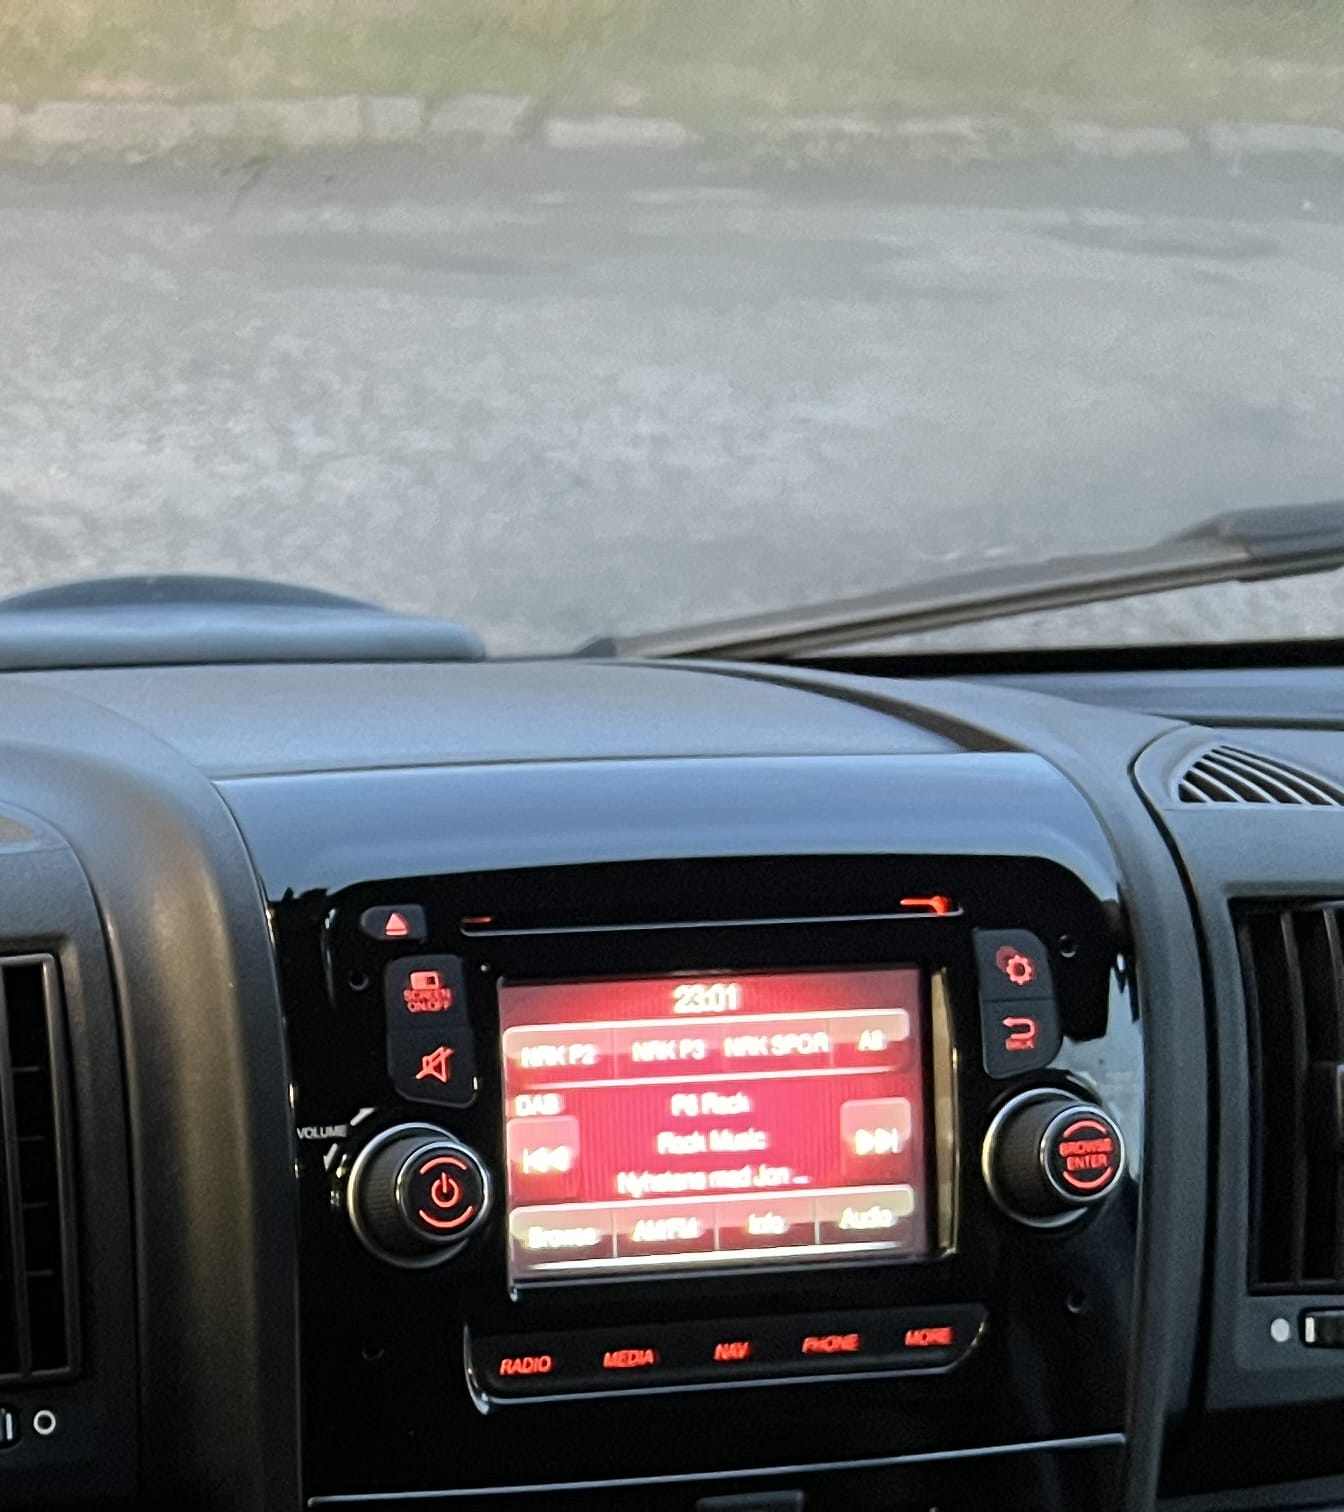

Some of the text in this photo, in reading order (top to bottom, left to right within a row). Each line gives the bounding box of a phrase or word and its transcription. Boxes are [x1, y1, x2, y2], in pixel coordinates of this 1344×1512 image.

[673, 984, 739, 1013] 23:01
[520, 1043, 597, 1067] NRK P2
[632, 1038, 706, 1062] NRK P3
[724, 1036, 769, 1057] NRK
[515, 1093, 561, 1116] DAB
[297, 1125, 348, 1139] VOLUME
[1067, 1154, 1107, 1170] ENTER
[838, 1206, 895, 1229] Audio
[802, 1333, 860, 1353] PHONE
[904, 1326, 953, 1346] MORE
[603, 1349, 655, 1368] MEDIA
[714, 1341, 750, 1360] NAV
[499, 1355, 552, 1375] RADIO
